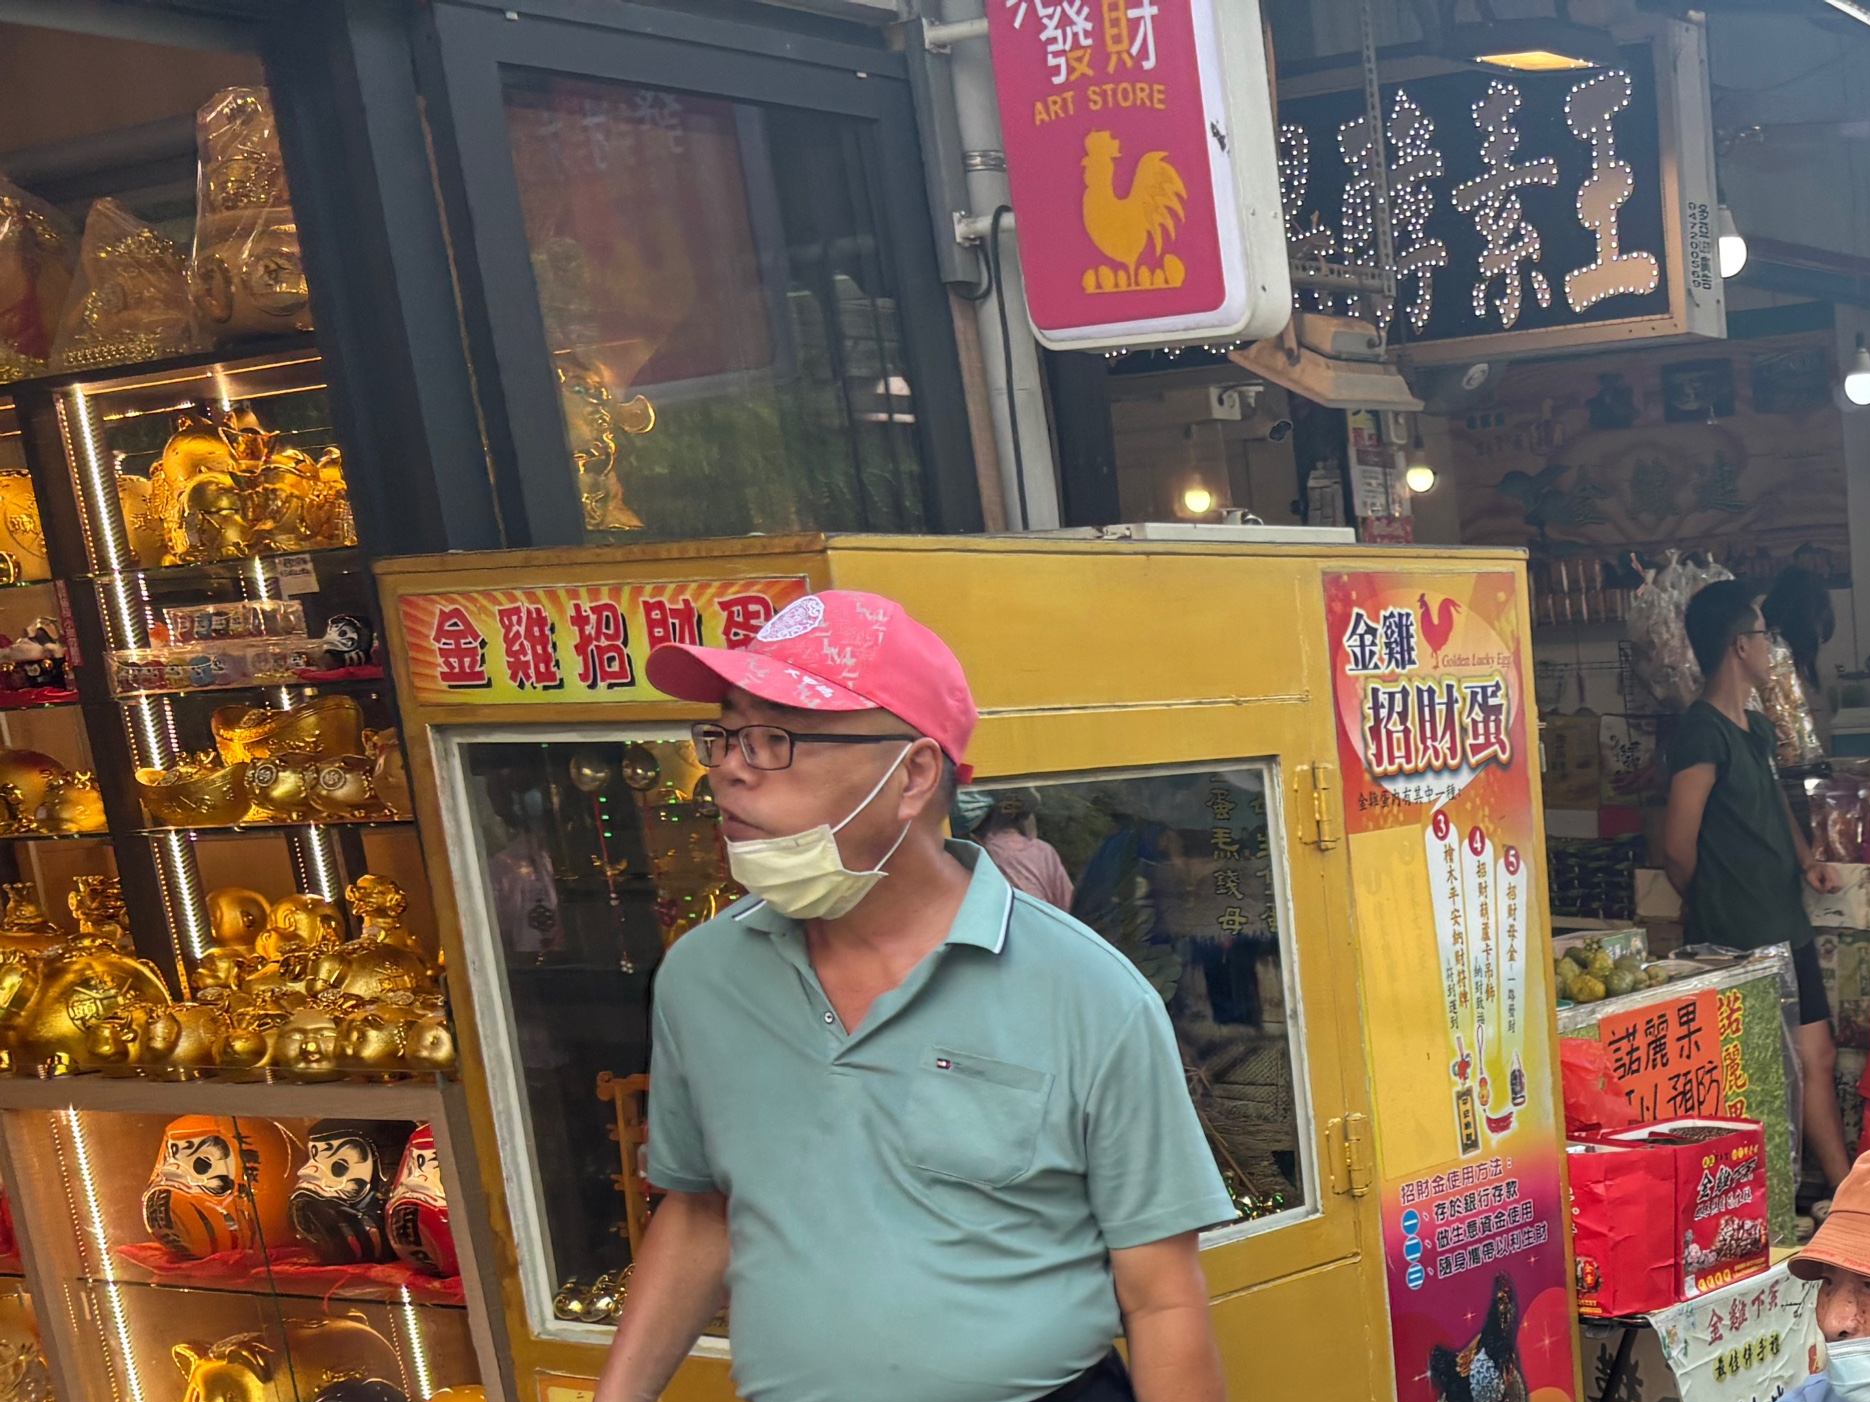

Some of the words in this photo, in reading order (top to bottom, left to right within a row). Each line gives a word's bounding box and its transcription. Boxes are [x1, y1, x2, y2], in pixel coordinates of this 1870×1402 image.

[1034, 90, 1076, 126] ART
[1087, 82, 1168, 111] STORE
[1345, 609, 1418, 672] 金雞
[1442, 653, 1470, 667] Golden
[1472, 653, 1494, 668] Lucky
[1497, 652, 1511, 668] Egg
[1366, 679, 1510, 772] 招財蛋
[1607, 1001, 1703, 1081] 諾麗果
[1625, 1060, 1722, 1121] 以預防
